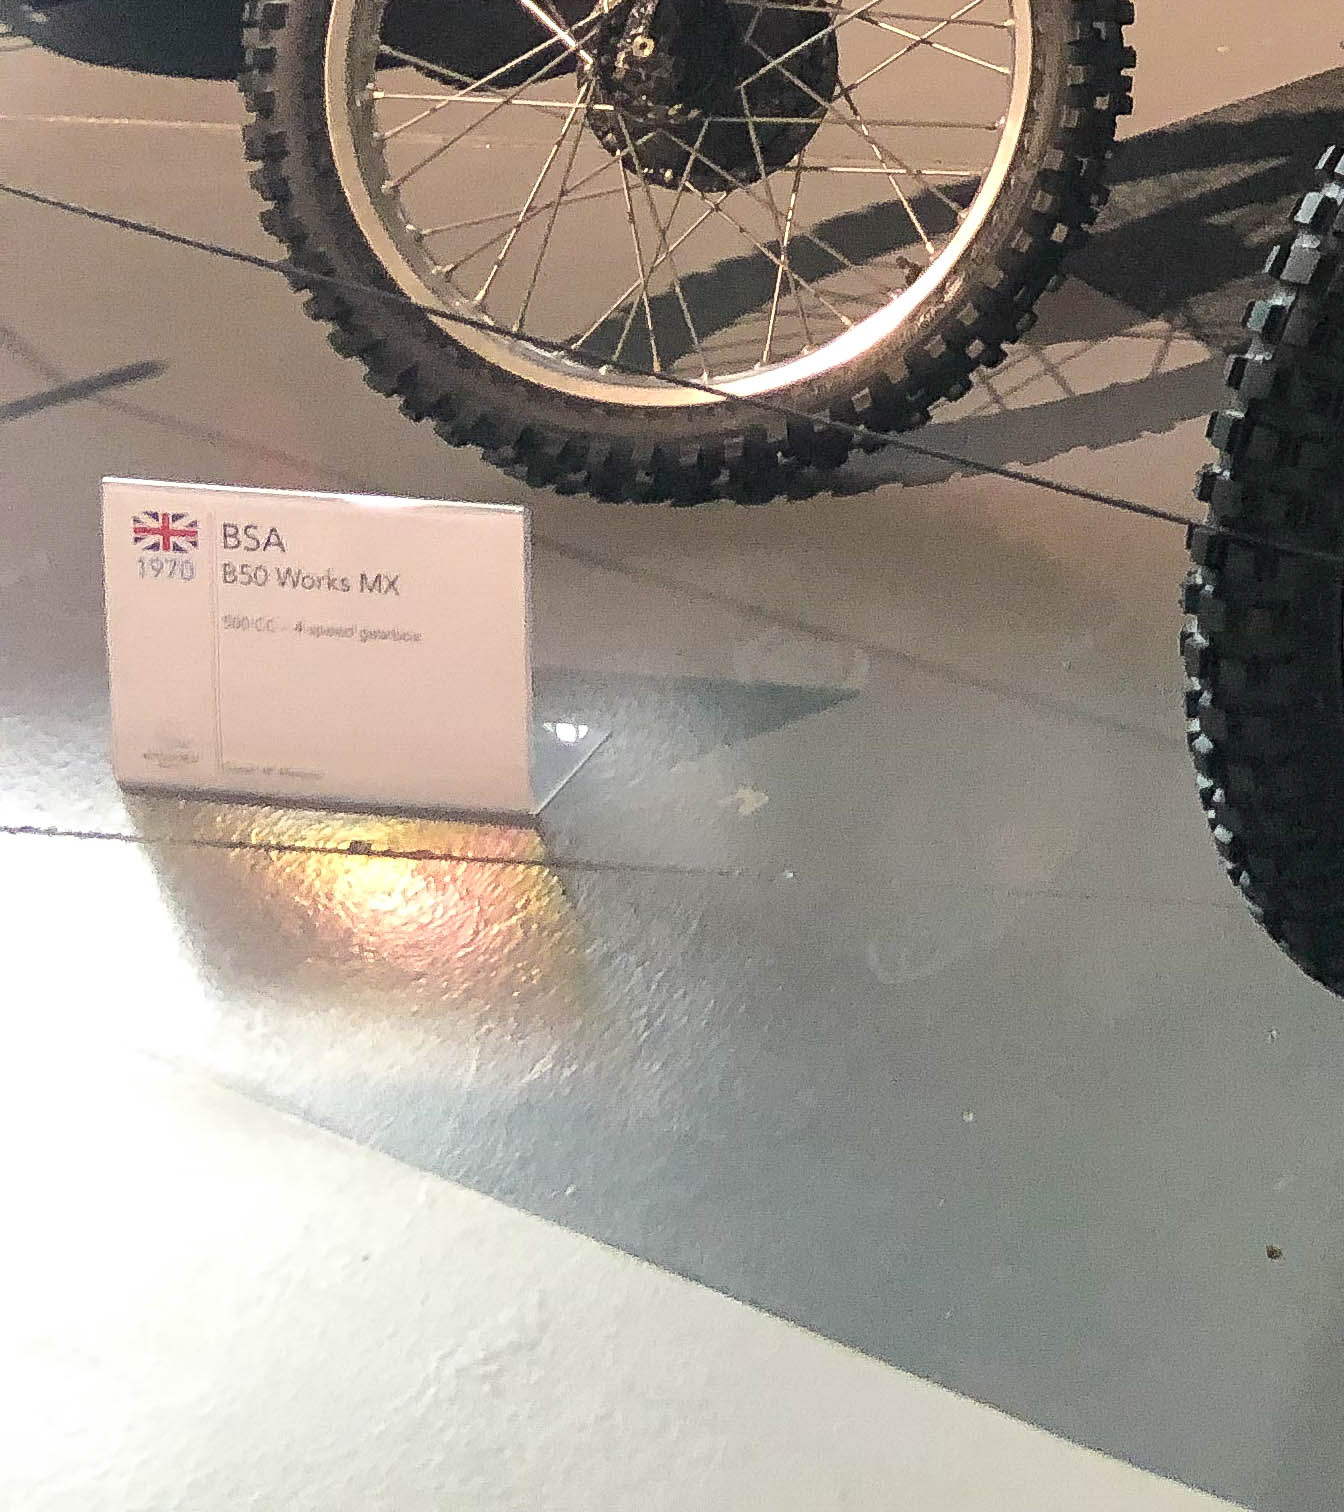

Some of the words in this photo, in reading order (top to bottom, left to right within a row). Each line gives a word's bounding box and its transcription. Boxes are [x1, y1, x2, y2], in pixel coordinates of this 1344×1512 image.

[222, 521, 287, 553] BSA
[137, 557, 196, 581] 1970
[222, 562, 268, 587] B50
[276, 567, 351, 593] Works
[359, 572, 400, 596] MX
